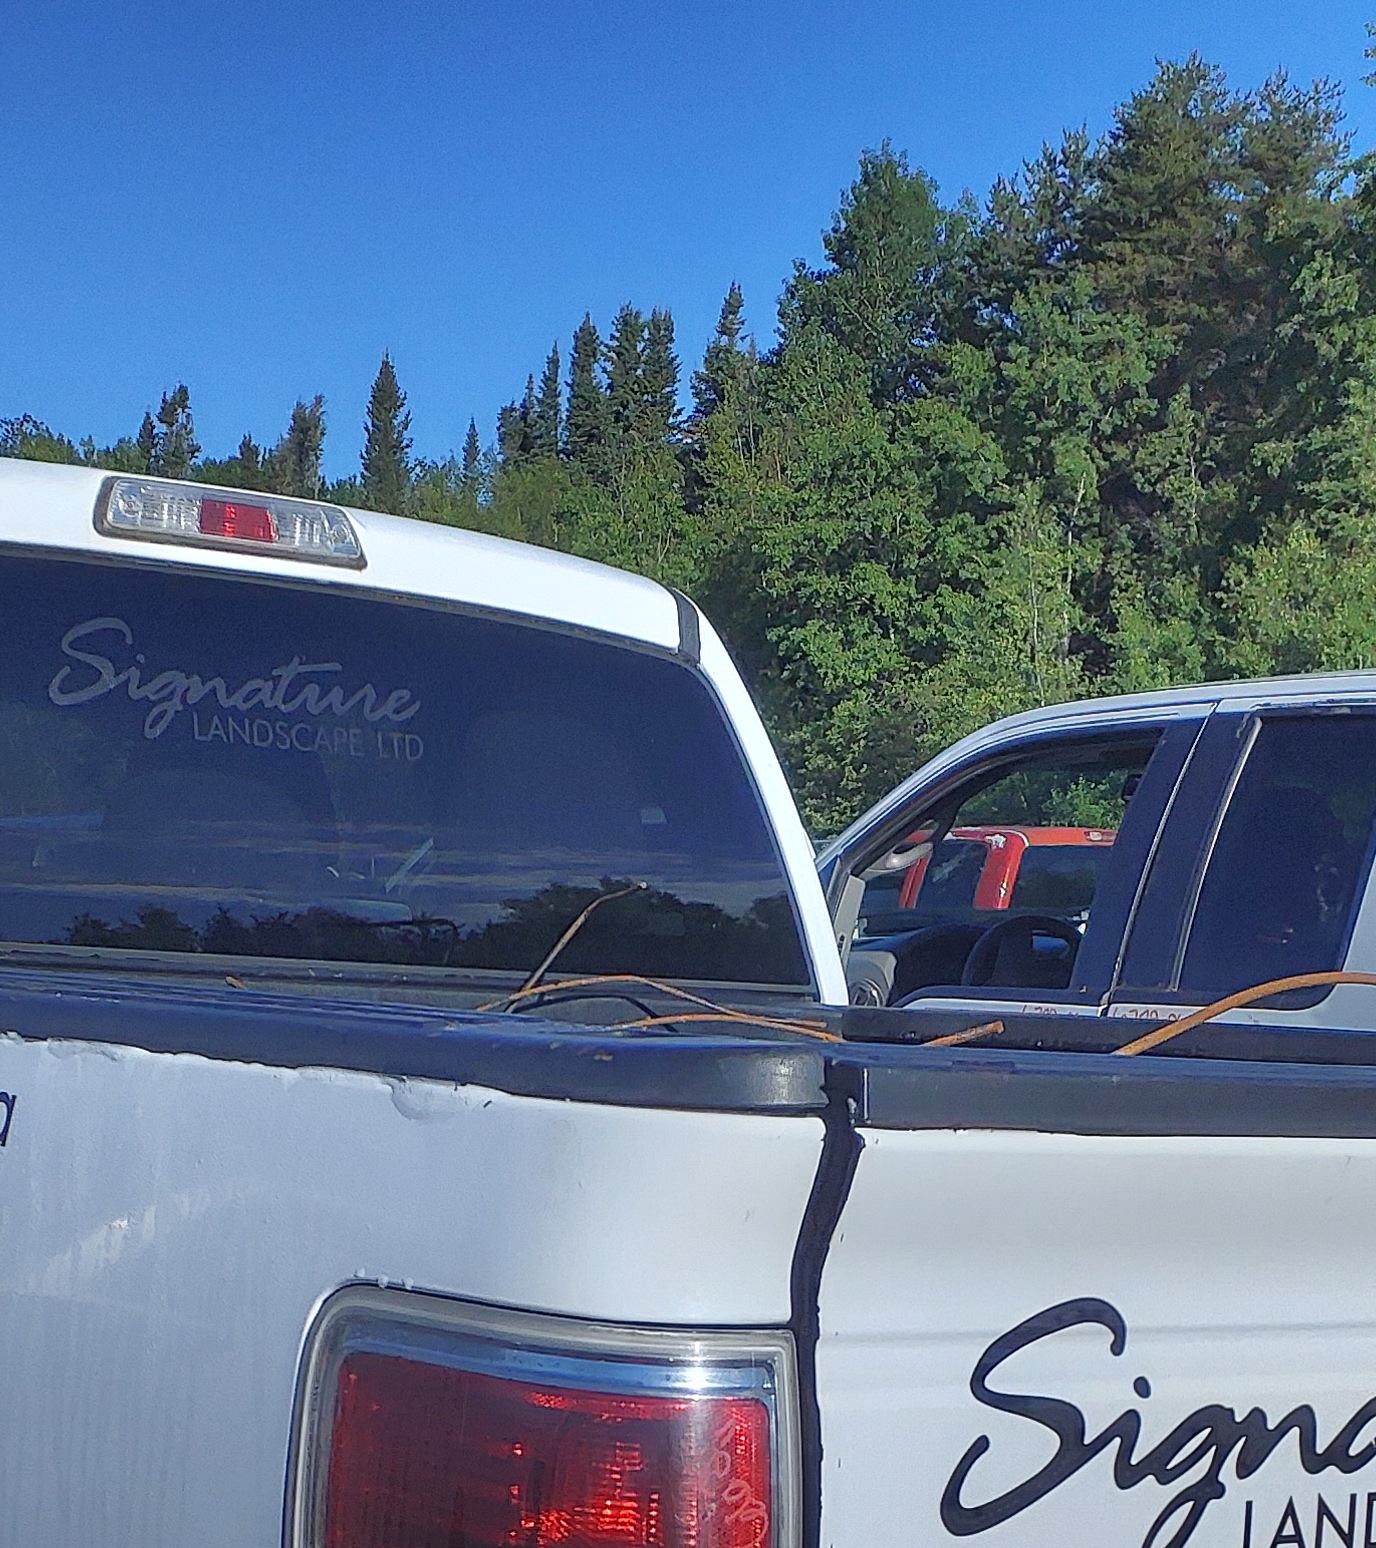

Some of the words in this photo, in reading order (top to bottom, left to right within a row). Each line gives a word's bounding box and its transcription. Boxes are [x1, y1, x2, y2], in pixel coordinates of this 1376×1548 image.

[48, 616, 420, 739] Signature
[192, 710, 365, 758] LANDSCAPE
[376, 729, 425, 762] LTD
